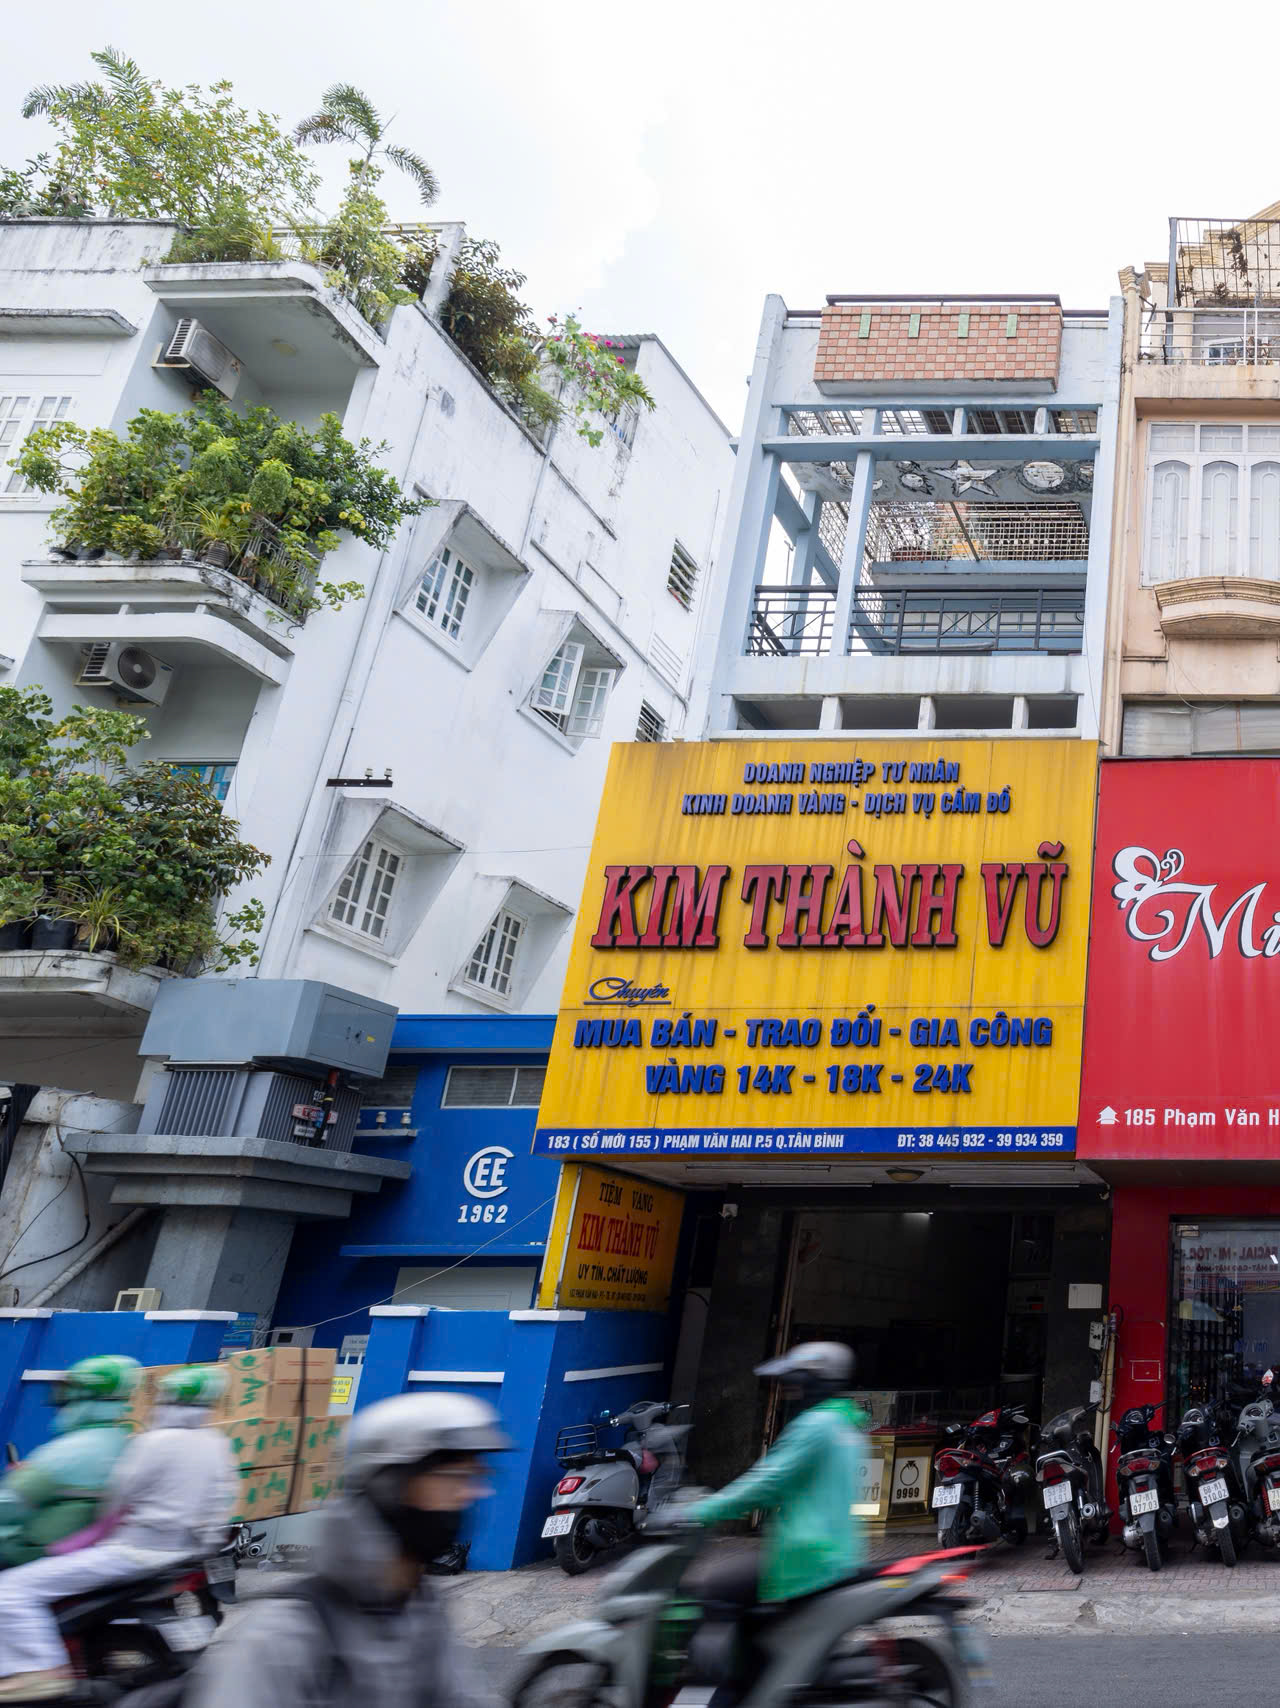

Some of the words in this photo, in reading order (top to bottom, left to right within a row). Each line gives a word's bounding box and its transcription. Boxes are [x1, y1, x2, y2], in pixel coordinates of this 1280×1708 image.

[743, 761, 805, 784] DOANH
[810, 758, 876, 787] NGHIỆP
[881, 760, 906, 783] TƯ
[909, 757, 960, 783] NHÂN
[681, 793, 728, 816] KINH
[730, 793, 794, 816] DOANH
[798, 789, 846, 815] VÀNG
[864, 792, 907, 819] DỊCH
[912, 792, 936, 819] VỤ
[590, 863, 731, 950] KIM
[740, 838, 965, 950] THÀNH
[979, 840, 1069, 950] VŨ
[588, 976, 671, 1008] Chuyên
[573, 1018, 643, 1048] MUA
[650, 1012, 718, 1048] BÁN
[746, 1018, 822, 1048] TRAO
[830, 1003, 882, 1047] ĐỔI
[909, 1017, 961, 1047] GIA
[969, 1011, 1054, 1048] CÔNG
[645, 1057, 726, 1094] VÀNG
[736, 1064, 796, 1094] 14K
[826, 1064, 885, 1094] 18K
[912, 1063, 975, 1094] 24K
[1123, 1107, 1157, 1127] 185
[1162, 1107, 1217, 1129] Phạm
[1223, 1107, 1261, 1127] Văn
[547, 1134, 570, 1150] 183
[581, 1131, 601, 1149] SỐ
[601, 1133, 626, 1149] MỚI
[629, 1134, 652, 1149] 155
[663, 1133, 700, 1151] PHẠM
[703, 1131, 728, 1149] VĂN
[731, 1133, 753, 1149] HAI
[755, 1133, 773, 1148] P.5
[813, 1131, 845, 1149] BÌNH
[897, 1133, 916, 1148] ĐT:
[918, 1133, 934, 1147] 38
[936, 1133, 960, 1147] 445
[962, 1133, 985, 1147] 932
[996, 1133, 1013, 1147] 39
[1015, 1133, 1038, 1147] 934
[1040, 1132, 1064, 1146] 359
[599, 1180, 624, 1207] TIỆM
[457, 1204, 509, 1224] 1962
[577, 1212, 605, 1251] KIM
[605, 1211, 645, 1257] THÀNH
[578, 1263, 590, 1280] UY
[895, 1486, 920, 1500] 9999
